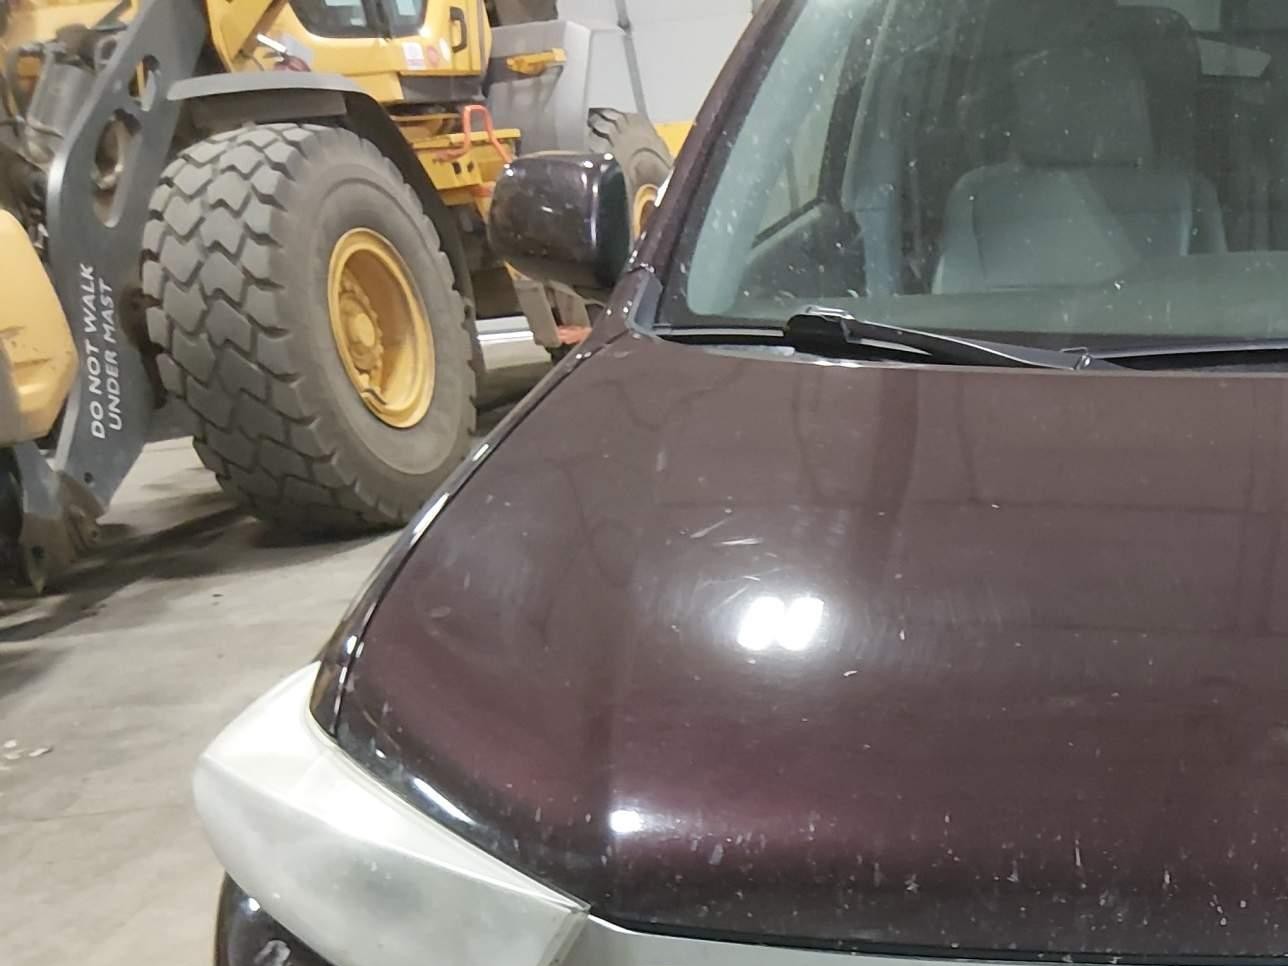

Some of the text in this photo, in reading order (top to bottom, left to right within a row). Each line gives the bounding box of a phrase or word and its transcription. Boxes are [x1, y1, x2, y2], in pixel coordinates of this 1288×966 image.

[80, 263, 106, 439] DO NOT WALK
[98, 277, 122, 431] UNDER MAST
